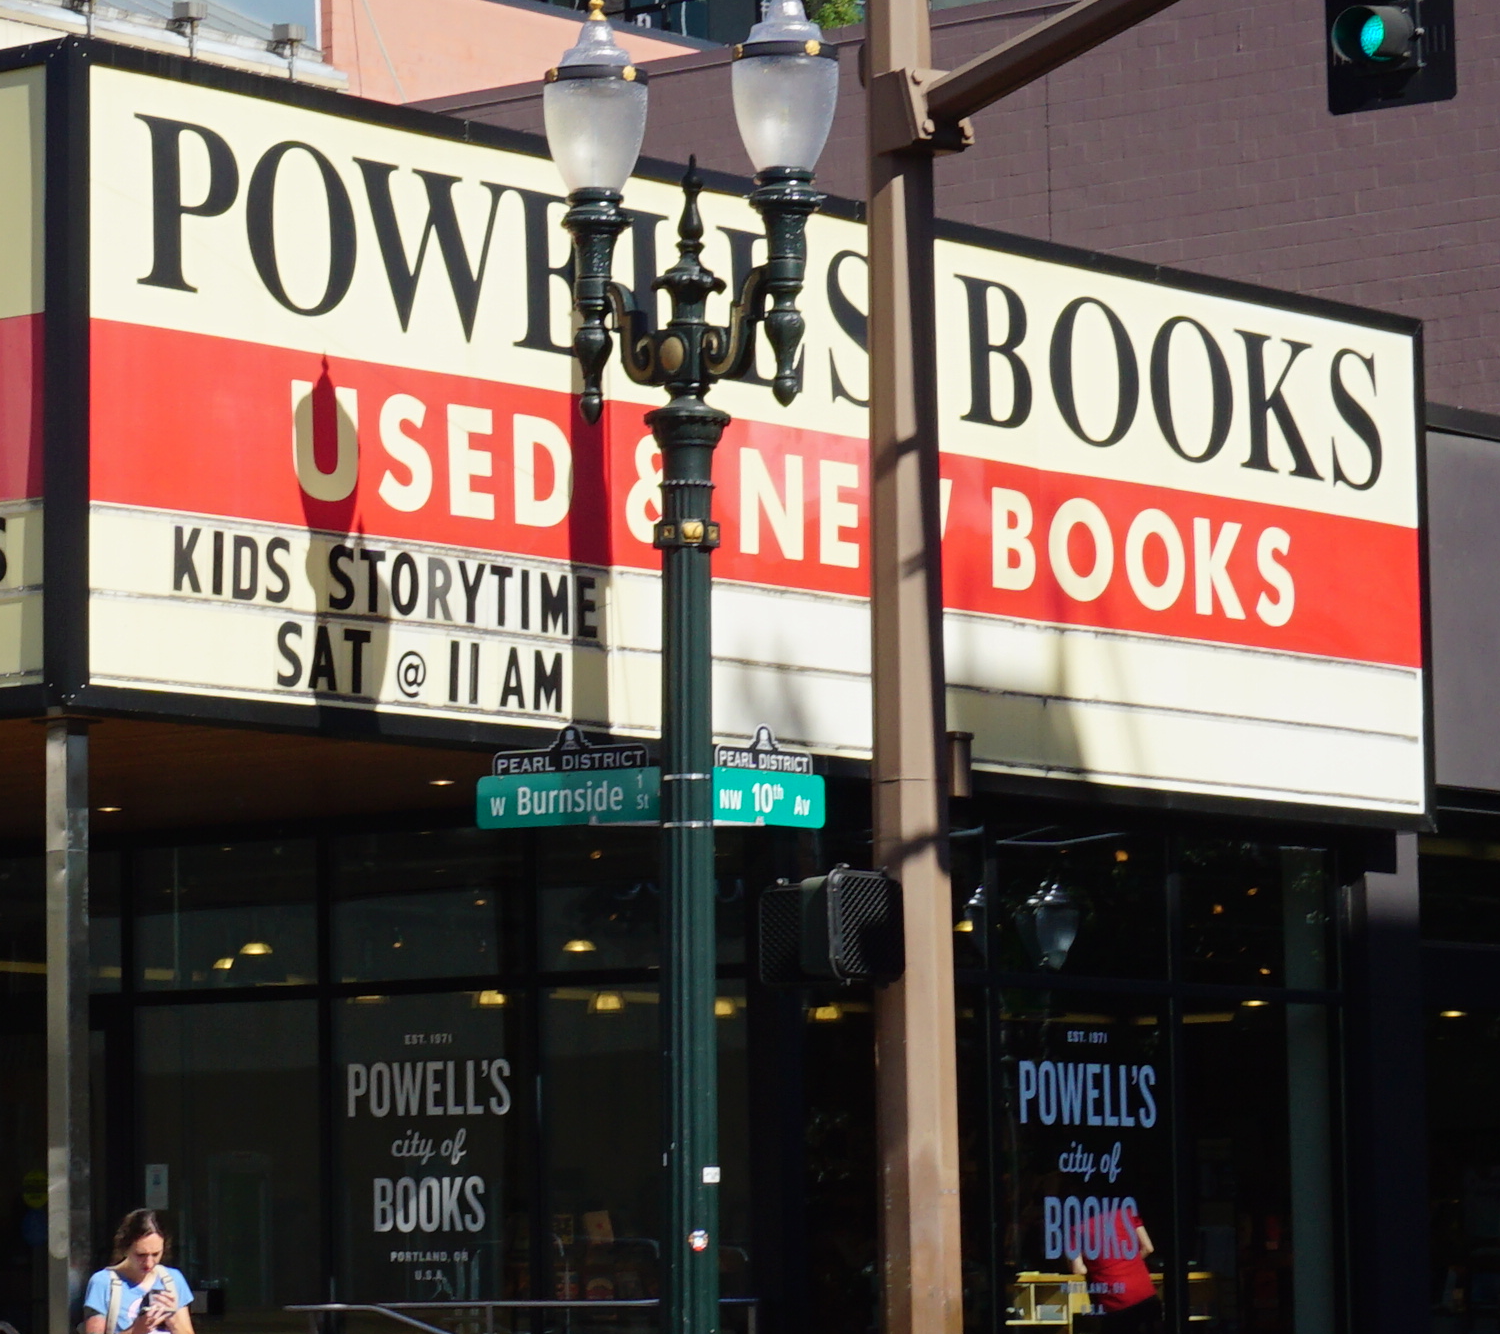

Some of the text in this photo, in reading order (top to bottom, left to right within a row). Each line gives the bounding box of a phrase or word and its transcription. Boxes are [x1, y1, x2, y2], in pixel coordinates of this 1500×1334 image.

[955, 273, 1385, 492] BOOKS
[290, 378, 573, 528] USED
[739, 447, 953, 569] NE
[992, 485, 1296, 627] BOOKS
[173, 525, 598, 639] KIDS STORYTIME
[276, 620, 372, 695] SAT
[396, 650, 427, 699] @
[499, 646, 563, 713] AM
[495, 750, 645, 774] PEARL DISTRICT
[718, 750, 809, 774] PEARL DISTRICT
[490, 781, 650, 817] W Burnside St
[719, 782, 811, 817] NW 10th Av
[404, 1033, 453, 1045] EST. 1971
[1066, 1030, 1108, 1044] EST. 1971
[347, 1058, 511, 1117] POWELL'S
[1018, 1060, 1157, 1129] POWELL'S
[391, 1127, 467, 1166] city of
[1058, 1140, 1122, 1184] city of
[373, 1175, 486, 1233] BOOKS
[1043, 1195, 1140, 1260] BOOKS
[390, 1251, 450, 1264] PORTLAND,
[414, 1269, 446, 1282] U.S.A.
